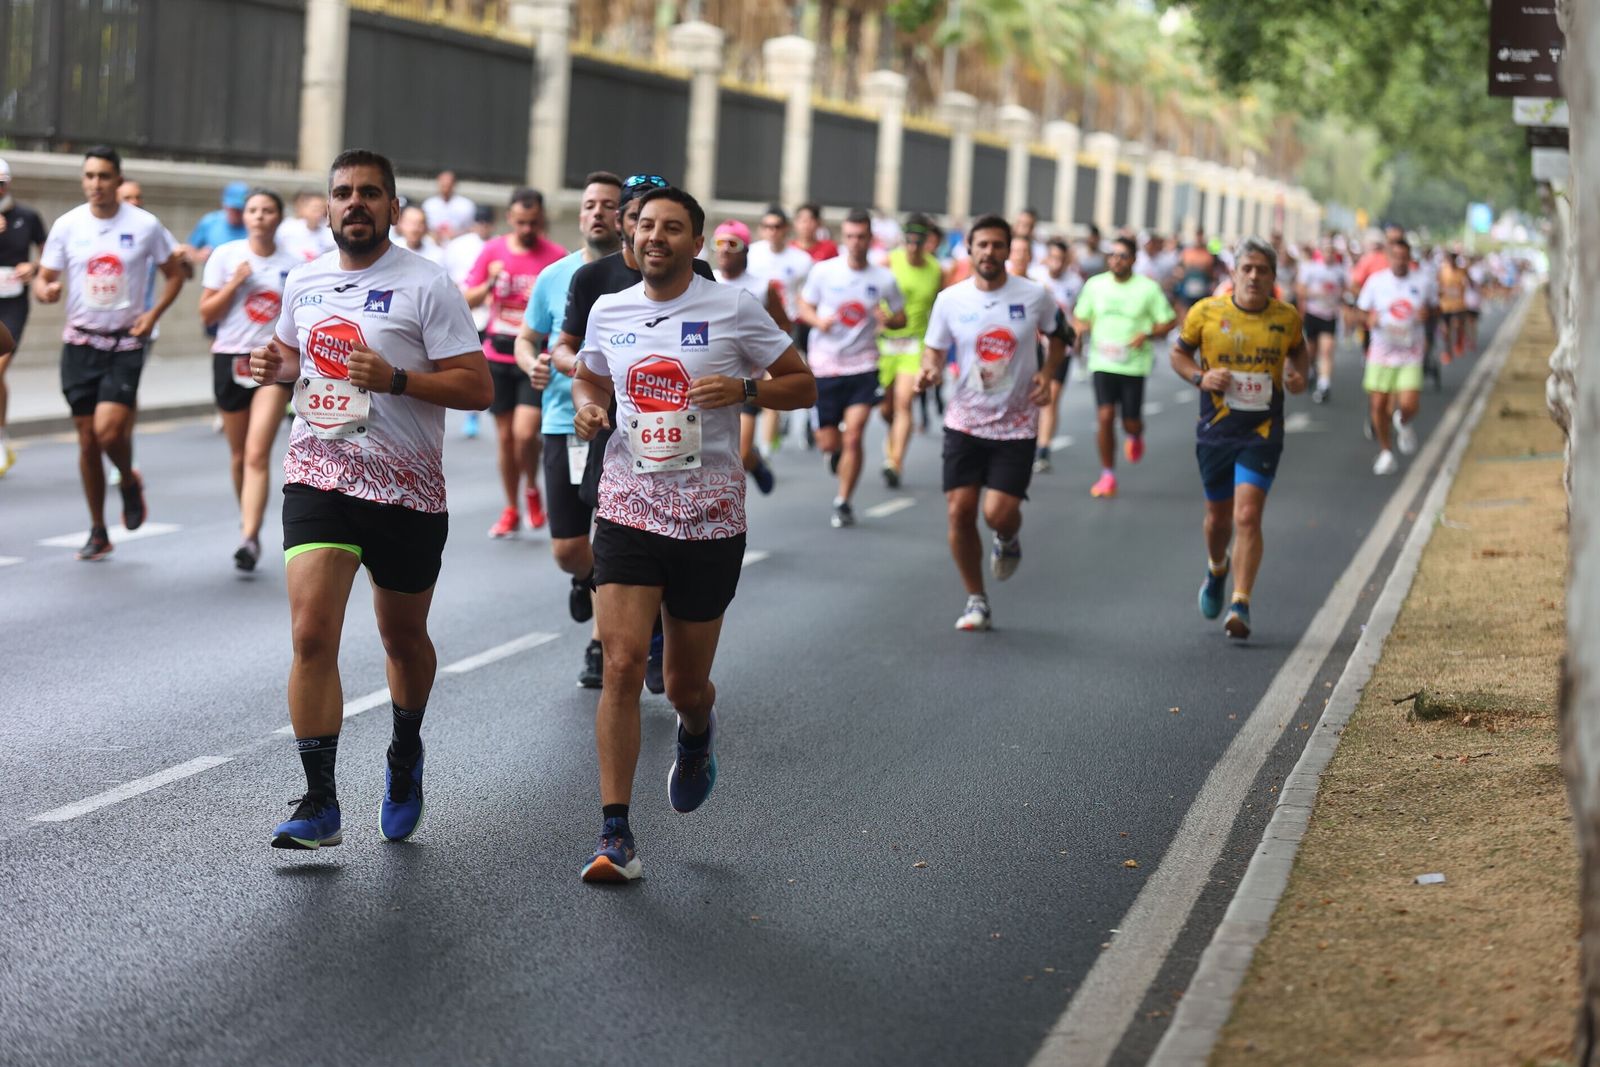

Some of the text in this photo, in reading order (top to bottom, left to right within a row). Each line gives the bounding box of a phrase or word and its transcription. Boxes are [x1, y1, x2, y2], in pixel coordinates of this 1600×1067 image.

[364, 300, 385, 311] AXA
[316, 331, 354, 353] PONL
[681, 333, 704, 344] AXA
[313, 344, 350, 365] FREN
[636, 372, 684, 392] PONLE
[308, 394, 351, 410] 367
[634, 385, 682, 404] FRENO
[641, 427, 682, 443] 648
